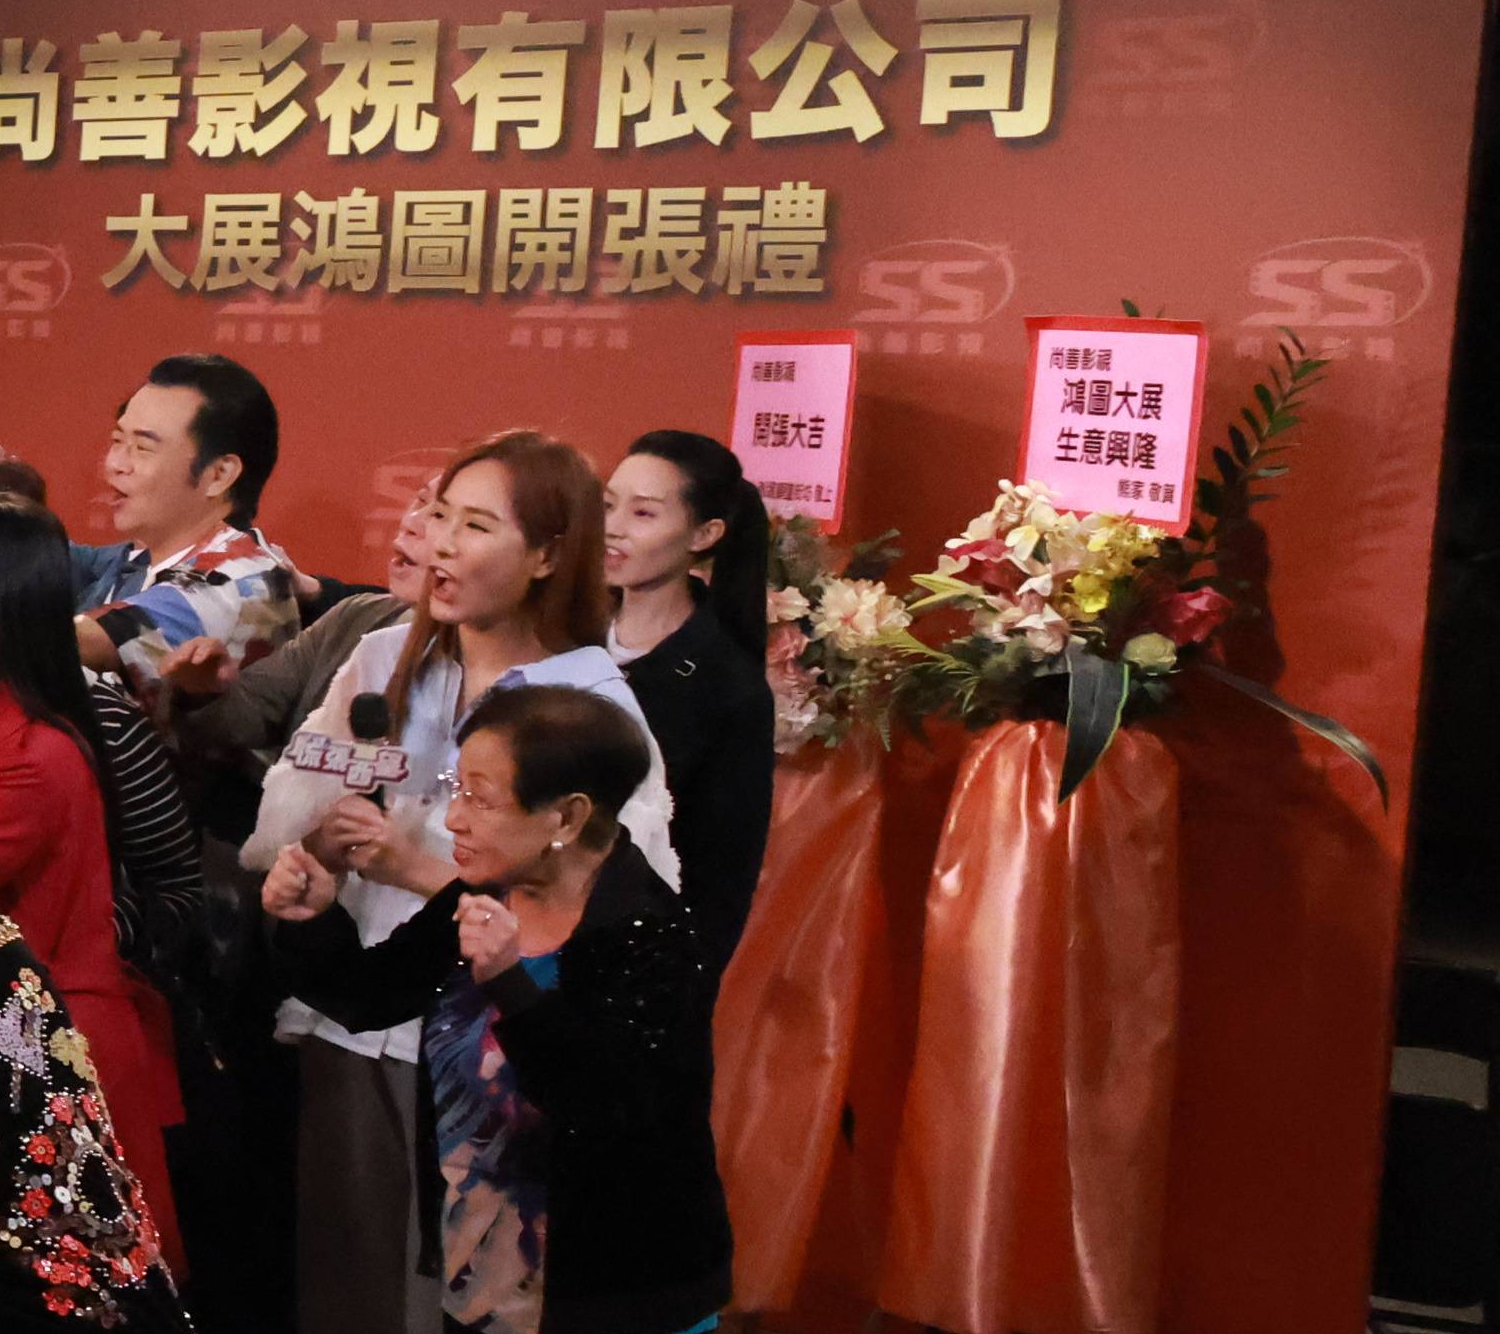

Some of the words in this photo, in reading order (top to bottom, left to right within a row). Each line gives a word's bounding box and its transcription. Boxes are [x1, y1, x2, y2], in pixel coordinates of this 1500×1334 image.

[100, 180, 827, 296] 大展鴻圖開張禮
[1060, 378, 1164, 420] 鴻圖大展
[1054, 426, 1158, 470] 生意興隆
